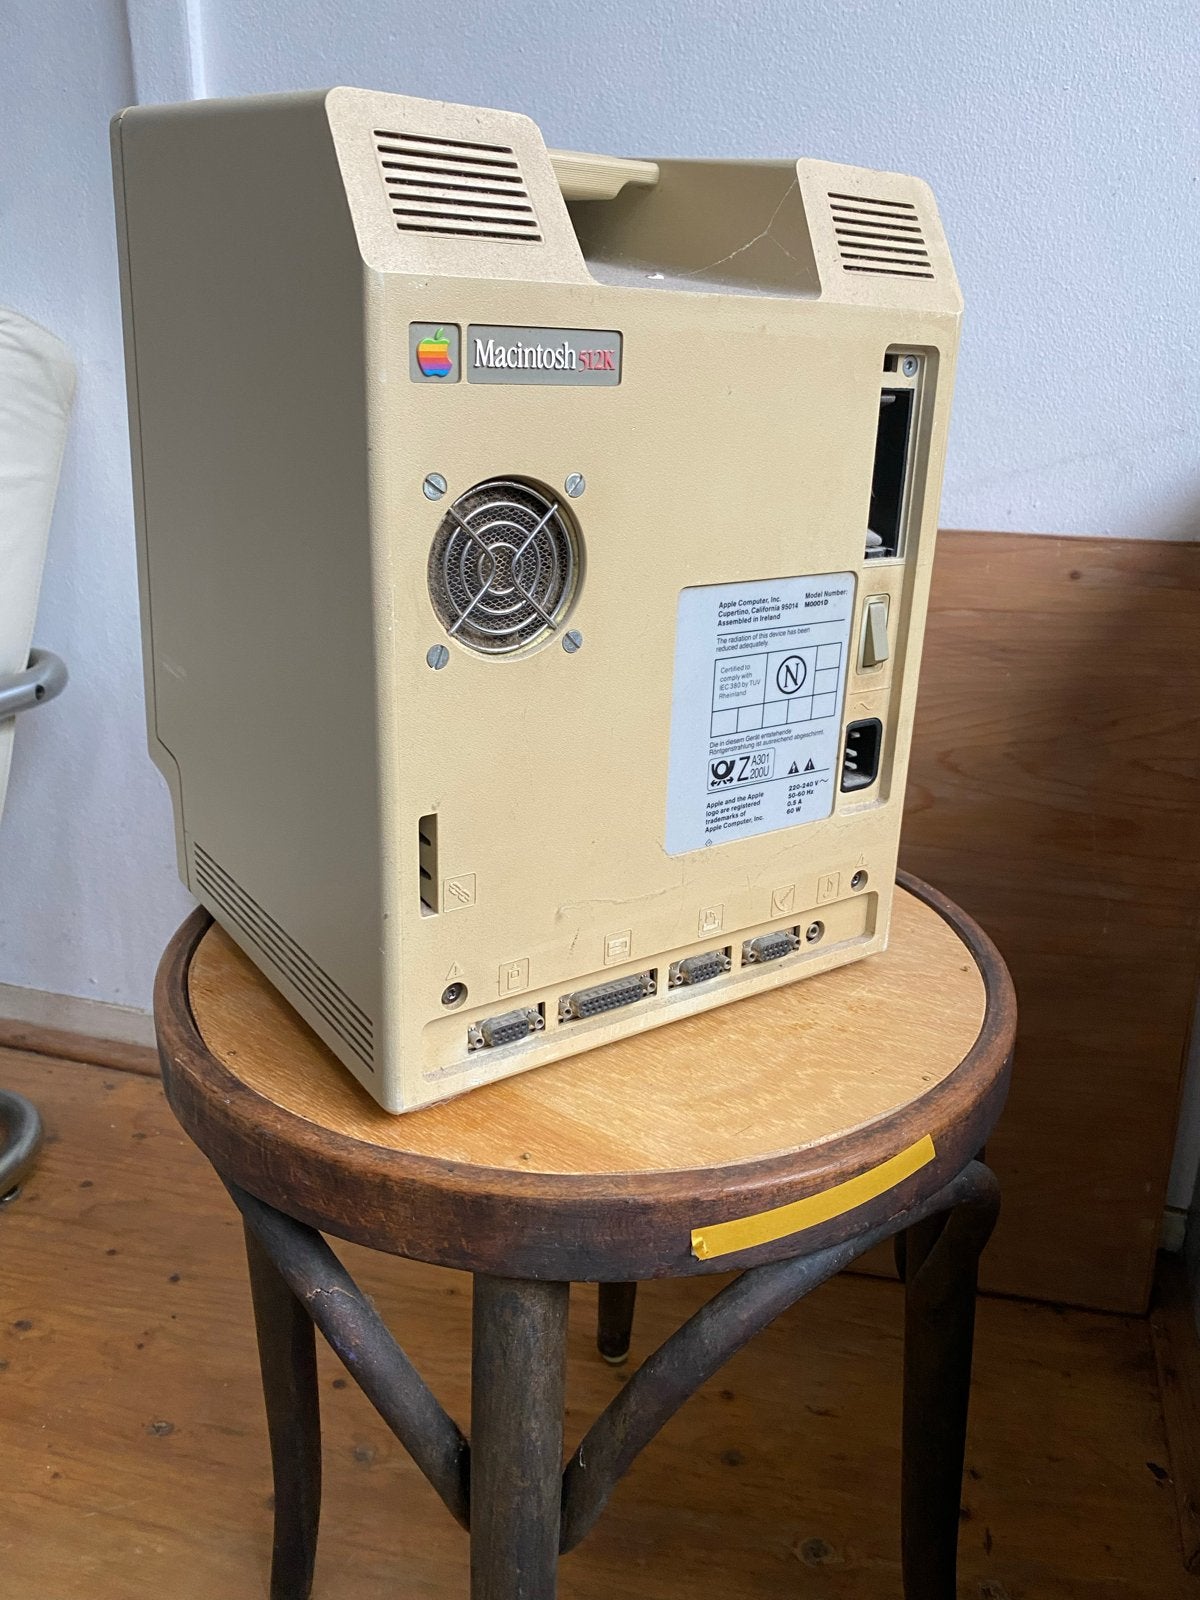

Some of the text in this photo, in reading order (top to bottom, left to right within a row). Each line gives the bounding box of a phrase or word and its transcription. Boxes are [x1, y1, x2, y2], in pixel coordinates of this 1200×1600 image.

[474, 339, 615, 372] Macintosh 512K
[805, 589, 848, 599] Model Number:
[718, 601, 736, 610] Apple
[738, 598, 770, 606] Computer,
[718, 602, 798, 618] Cupertino, California 95014
[717, 617, 752, 626] Assembled
[760, 613, 781, 622] Ireland
[728, 635, 752, 644] radiation
[769, 630, 786, 638] device
[716, 644, 738, 653] reduced
[720, 665, 744, 674] Certified
[783, 662, 800, 688] N
[720, 674, 740, 682] comply
[718, 690, 746, 699] Rheinland
[726, 738, 744, 746] diesem
[760, 729, 792, 739] entstehende
[708, 742, 755, 756] Röntgenstrahlung
[762, 736, 793, 746] ausreichend
[737, 753, 770, 782] Z A301
[750, 765, 770, 780] 200U
[788, 782, 814, 792] 220-240
[706, 800, 724, 809] Apple
[747, 792, 764, 800] Apple
[788, 790, 805, 799] 50-60
[705, 810, 719, 818] logo
[730, 800, 761, 812] registered
[704, 825, 722, 833] Apple
[723, 819, 753, 828] Computer,
[705, 814, 739, 825] trademarks
